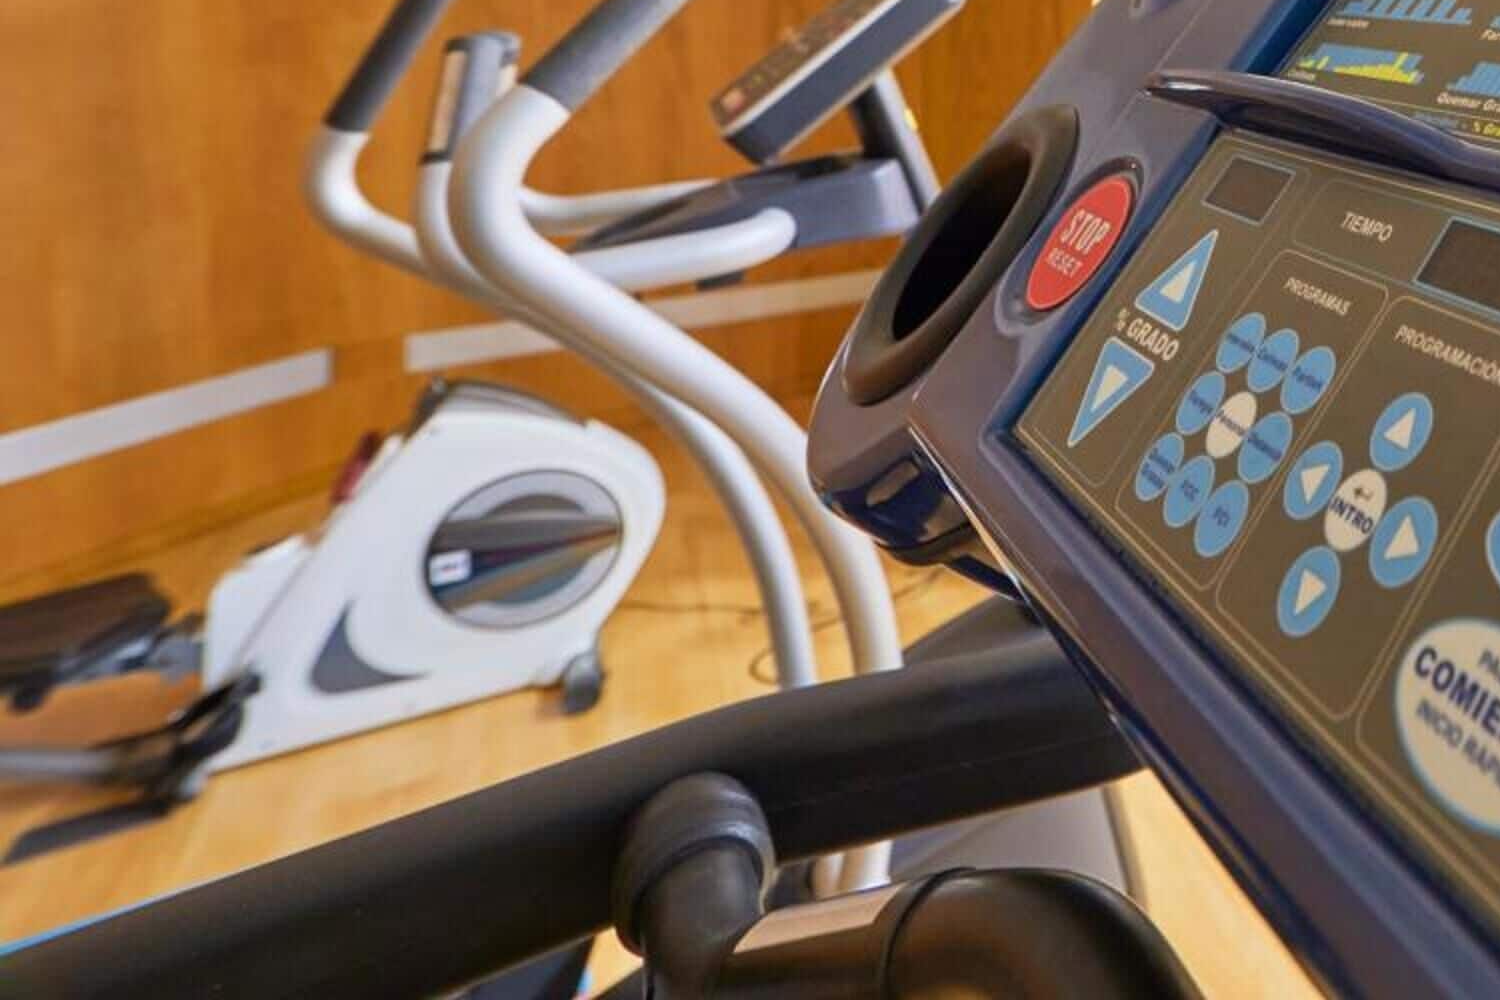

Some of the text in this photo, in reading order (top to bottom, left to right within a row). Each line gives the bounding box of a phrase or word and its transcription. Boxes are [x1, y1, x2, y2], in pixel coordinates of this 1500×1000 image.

[1060, 208, 1112, 255] STOP
[1341, 211, 1393, 243] TIEMPO
[1047, 247, 1084, 279] RESET
[1284, 276, 1351, 317] PROGRAMAS
[1127, 317, 1180, 361] GRADO
[1328, 496, 1375, 536] INTRO
[1416, 698, 1464, 748] INICIO
